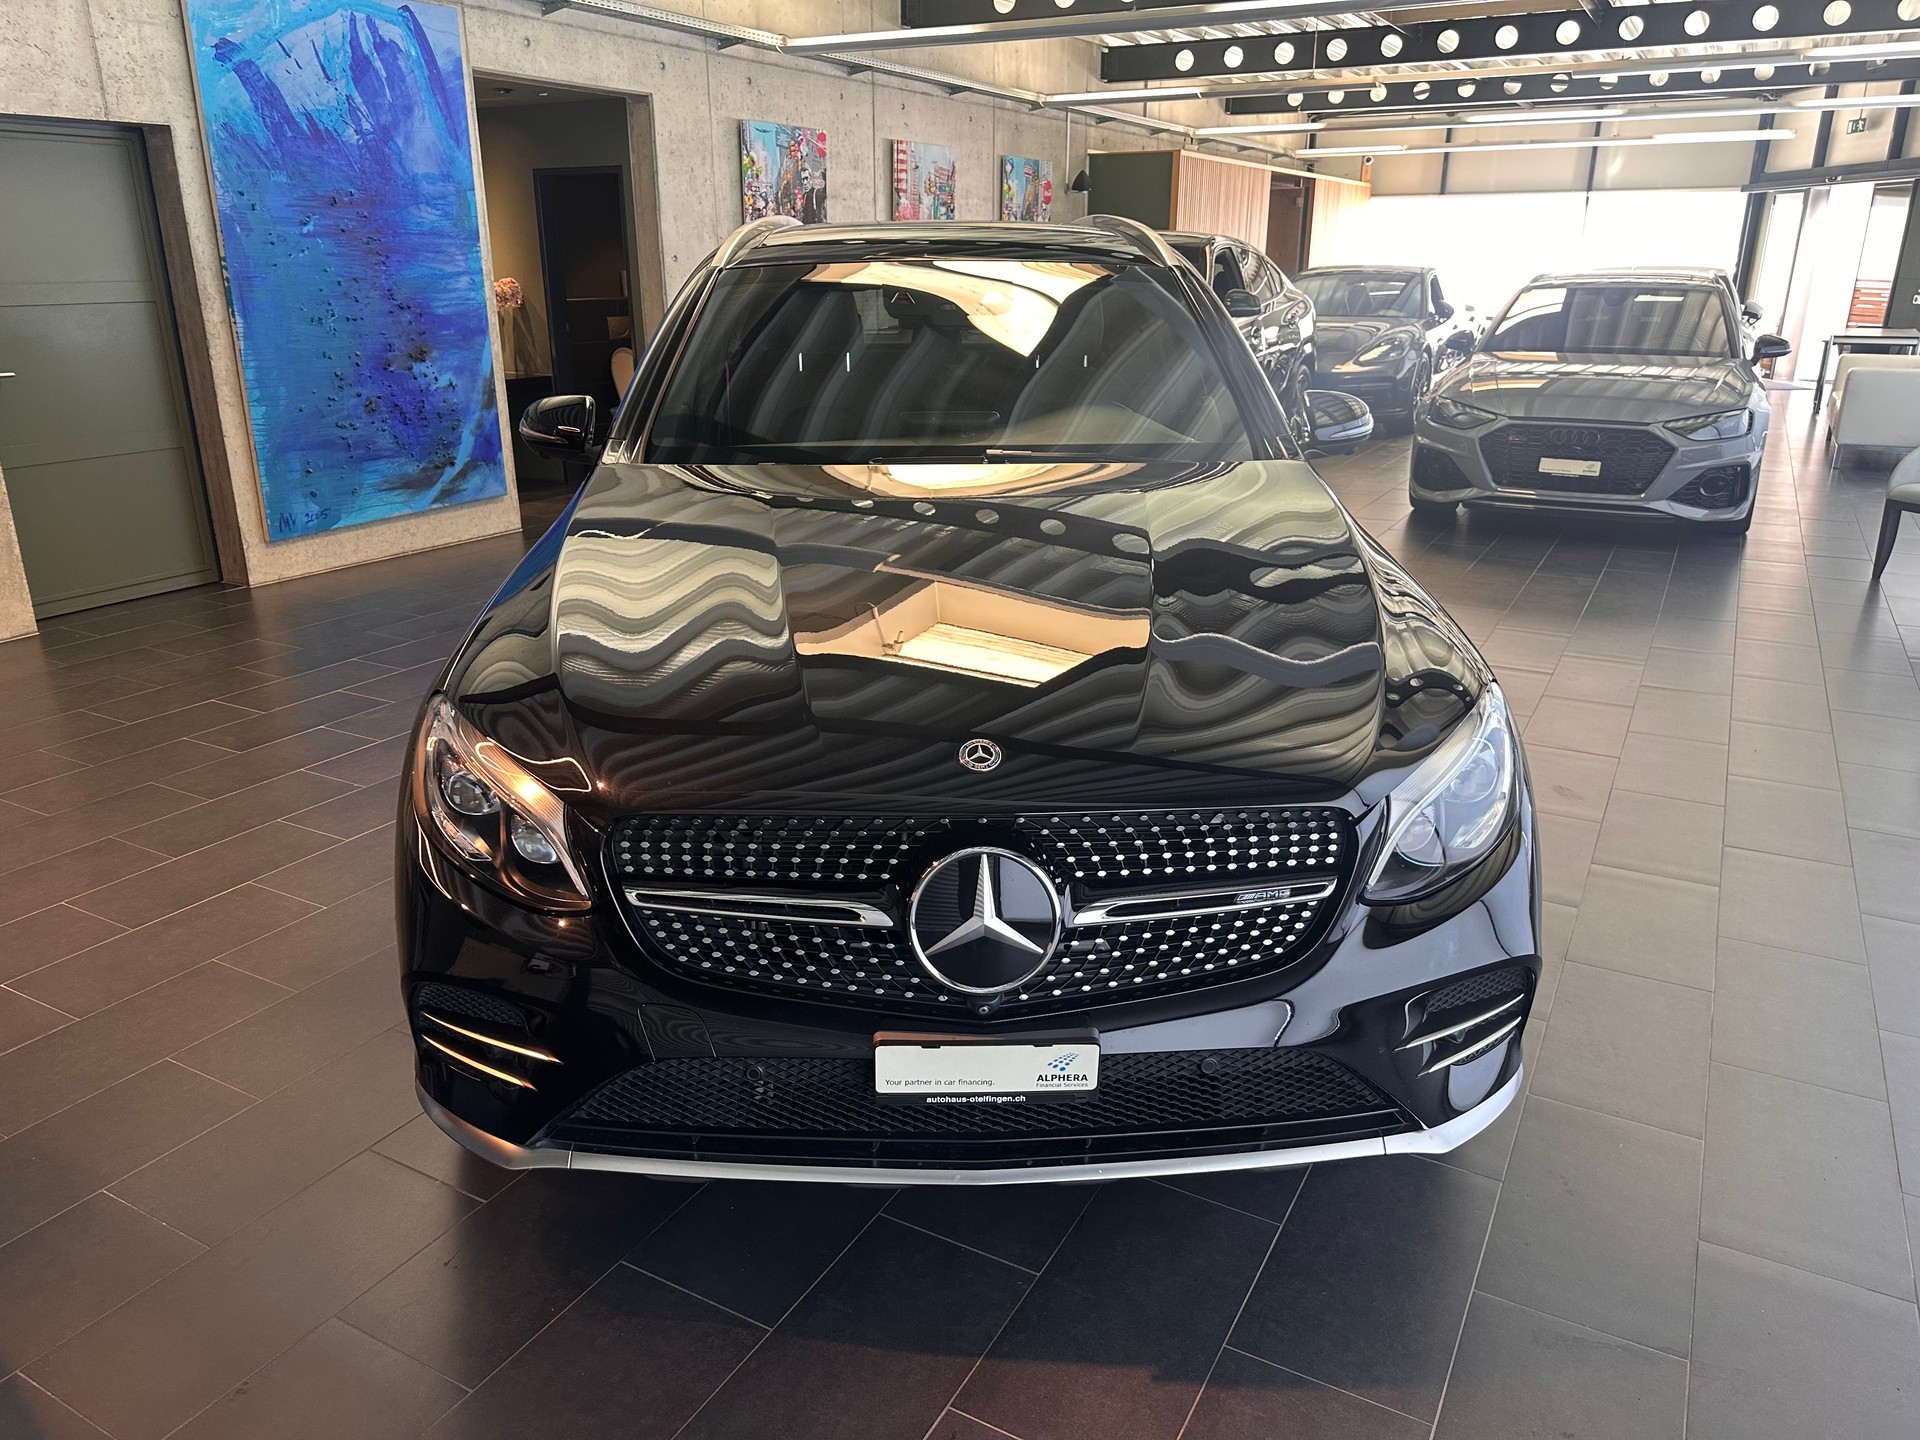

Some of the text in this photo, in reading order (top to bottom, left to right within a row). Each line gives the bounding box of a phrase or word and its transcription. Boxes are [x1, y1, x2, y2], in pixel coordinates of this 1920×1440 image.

[1036, 1074, 1088, 1082] ALPHERA
[904, 1079, 932, 1087] partner
[958, 1079, 995, 1087] financing.
[926, 1095, 1026, 1104] autohaus-otelfingen.ch
